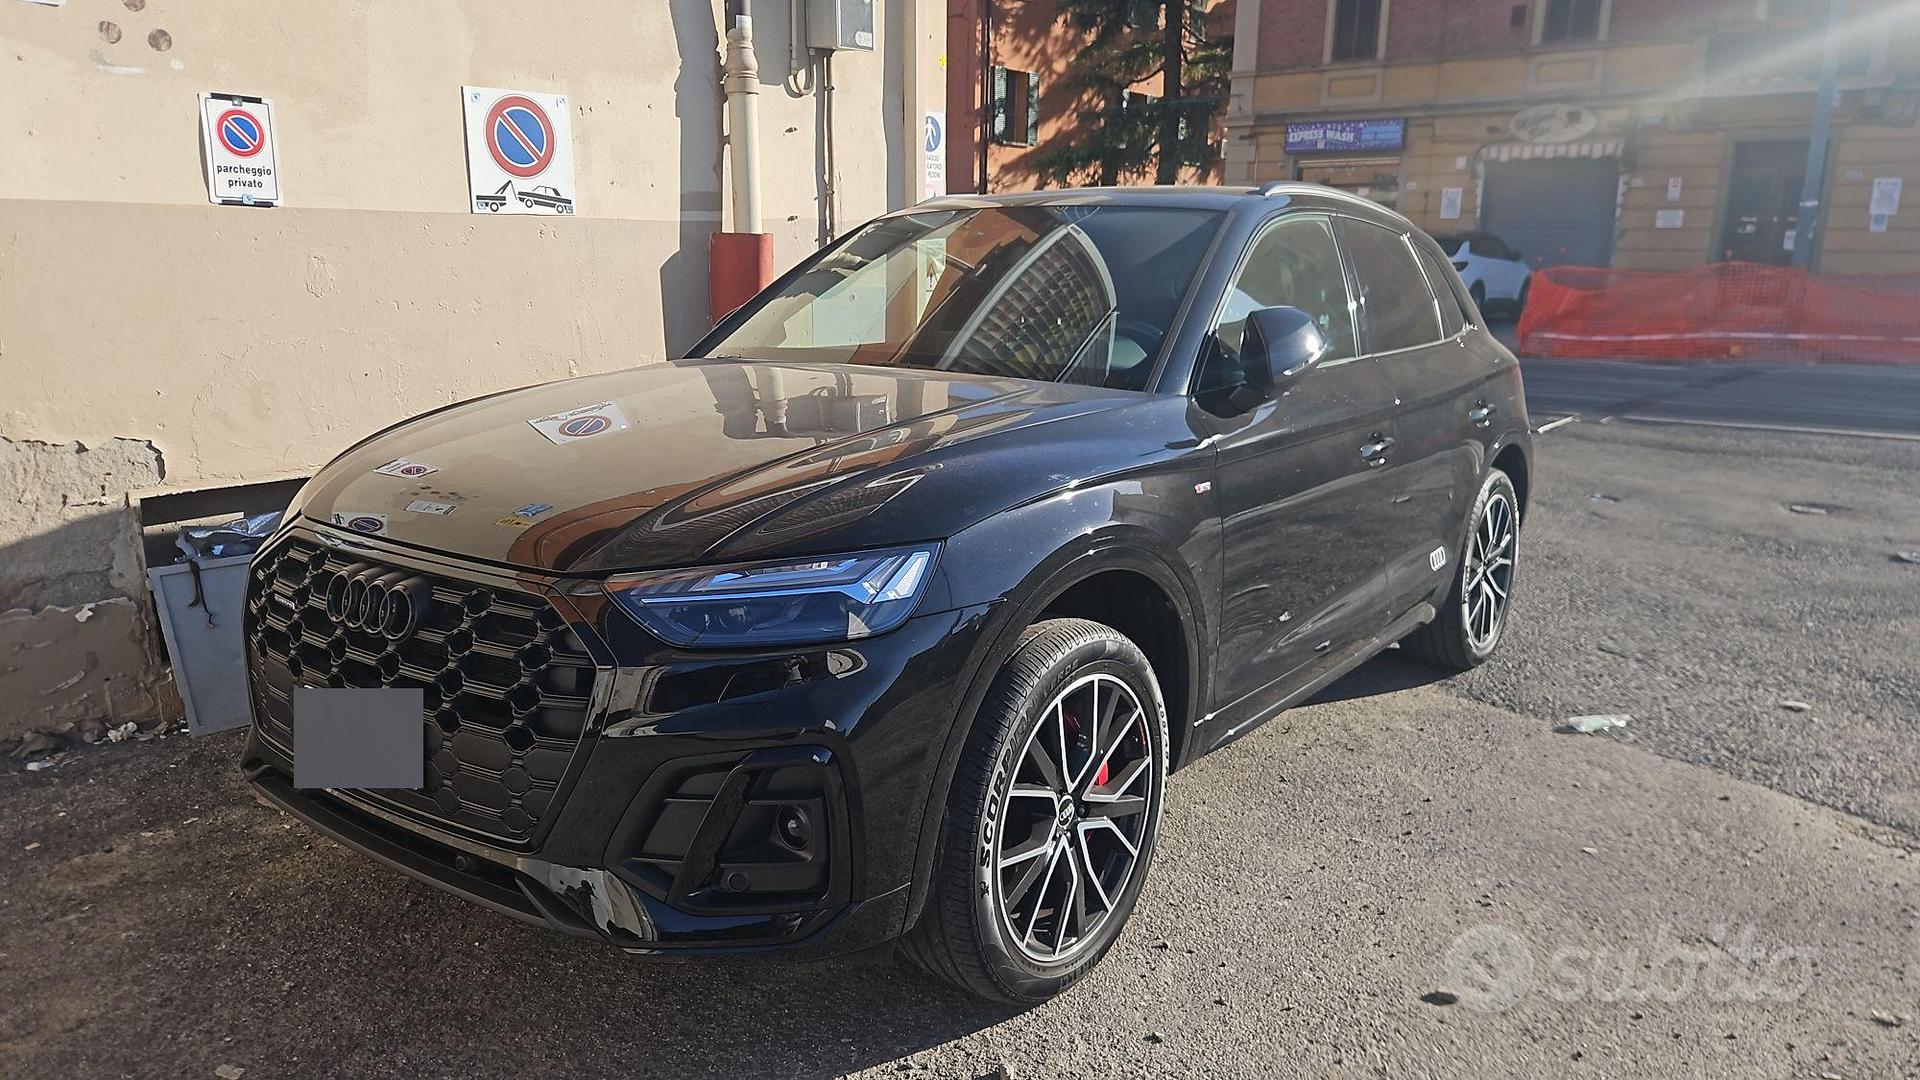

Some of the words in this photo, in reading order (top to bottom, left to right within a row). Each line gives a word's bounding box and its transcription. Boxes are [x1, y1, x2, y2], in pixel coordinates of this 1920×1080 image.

[1288, 129, 1324, 143] EXPRESS
[1326, 129, 1354, 142] WASH
[216, 164, 272, 177] parcheggio
[228, 177, 263, 189] privato
[979, 699, 1037, 868] SCORPION
